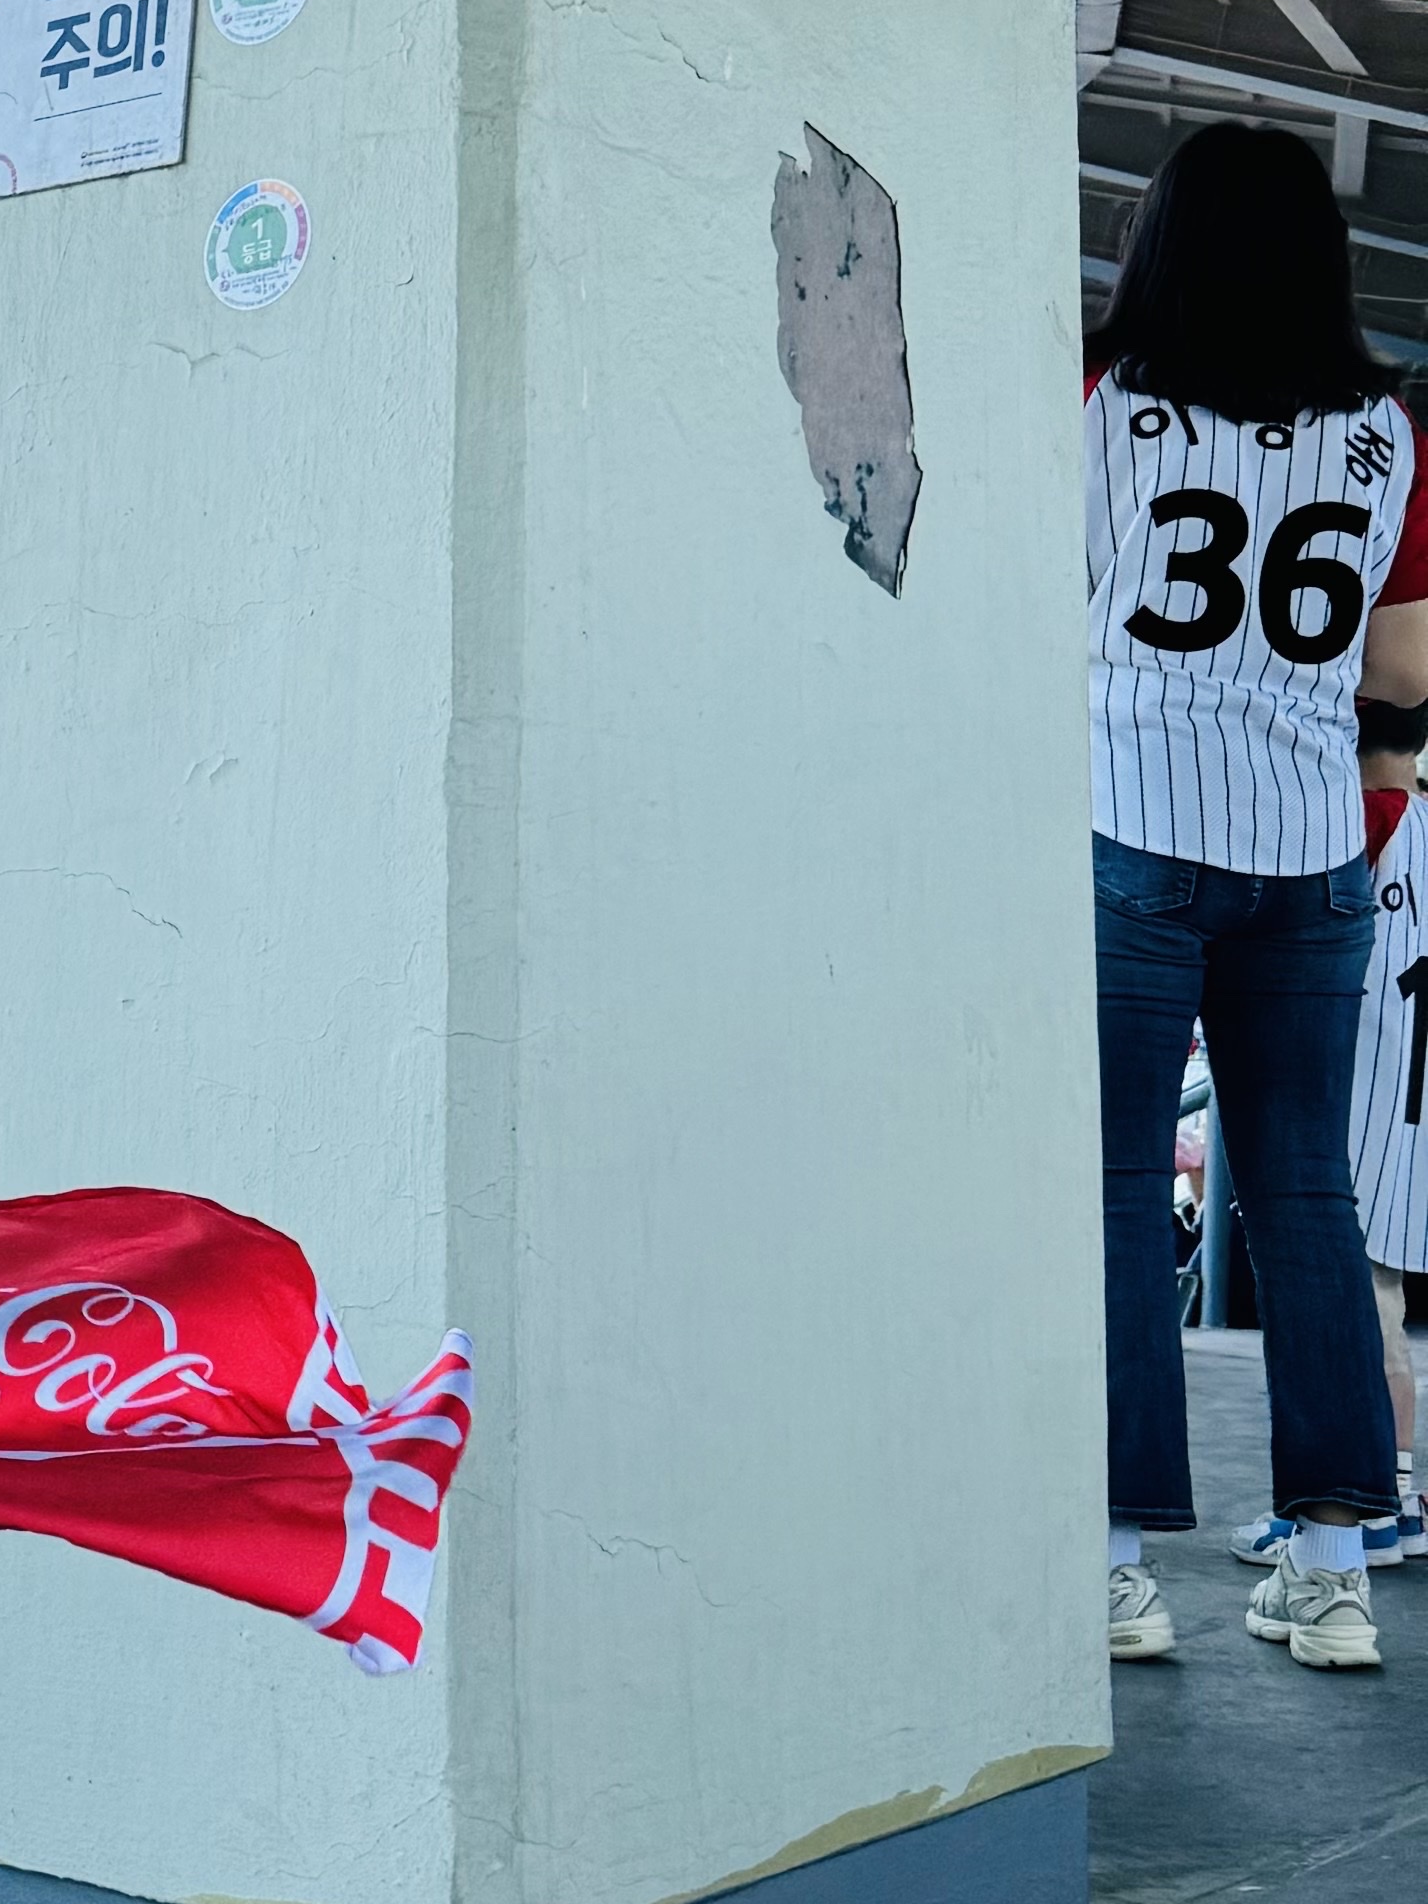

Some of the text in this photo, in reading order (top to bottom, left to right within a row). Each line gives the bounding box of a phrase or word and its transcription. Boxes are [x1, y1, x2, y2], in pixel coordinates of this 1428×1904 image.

[251, 217, 264, 240] 1
[241, 239, 273, 265] 등급
[1122, 486, 1372, 666] 36
